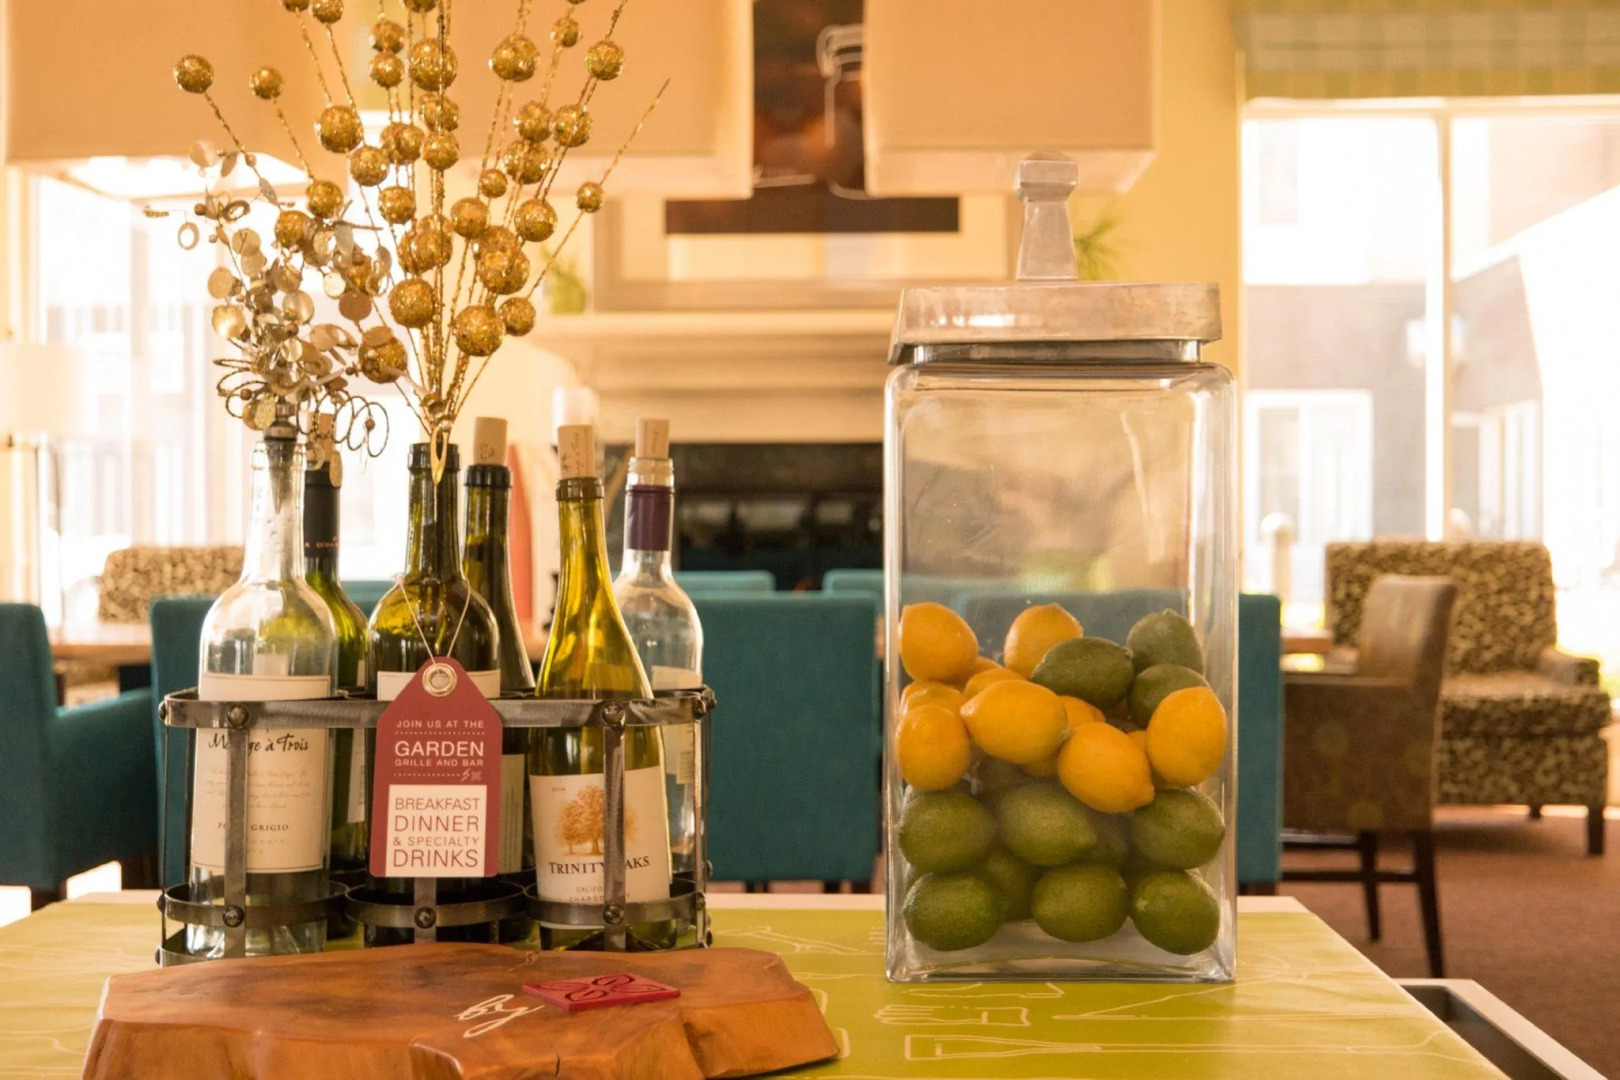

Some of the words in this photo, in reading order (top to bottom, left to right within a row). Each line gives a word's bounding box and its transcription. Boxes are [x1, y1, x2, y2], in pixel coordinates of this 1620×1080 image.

[396, 719, 423, 729] JOIN
[427, 719, 442, 729] US
[446, 719, 459, 729] AT
[463, 719, 485, 729] THE
[276, 732, 309, 752] Trois
[394, 740, 484, 757] GARDEN
[394, 758, 433, 768] GRILLE
[436, 758, 459, 768] AND
[461, 758, 485, 768] BAR
[394, 797, 481, 811] BREAKFAST
[250, 823, 289, 832] GRIGIO
[394, 815, 479, 832] DINNER
[393, 836, 402, 847] &
[407, 836, 480, 847] SPECIALTY
[393, 848, 479, 868] DRINKS
[624, 856, 651, 869] AKS
